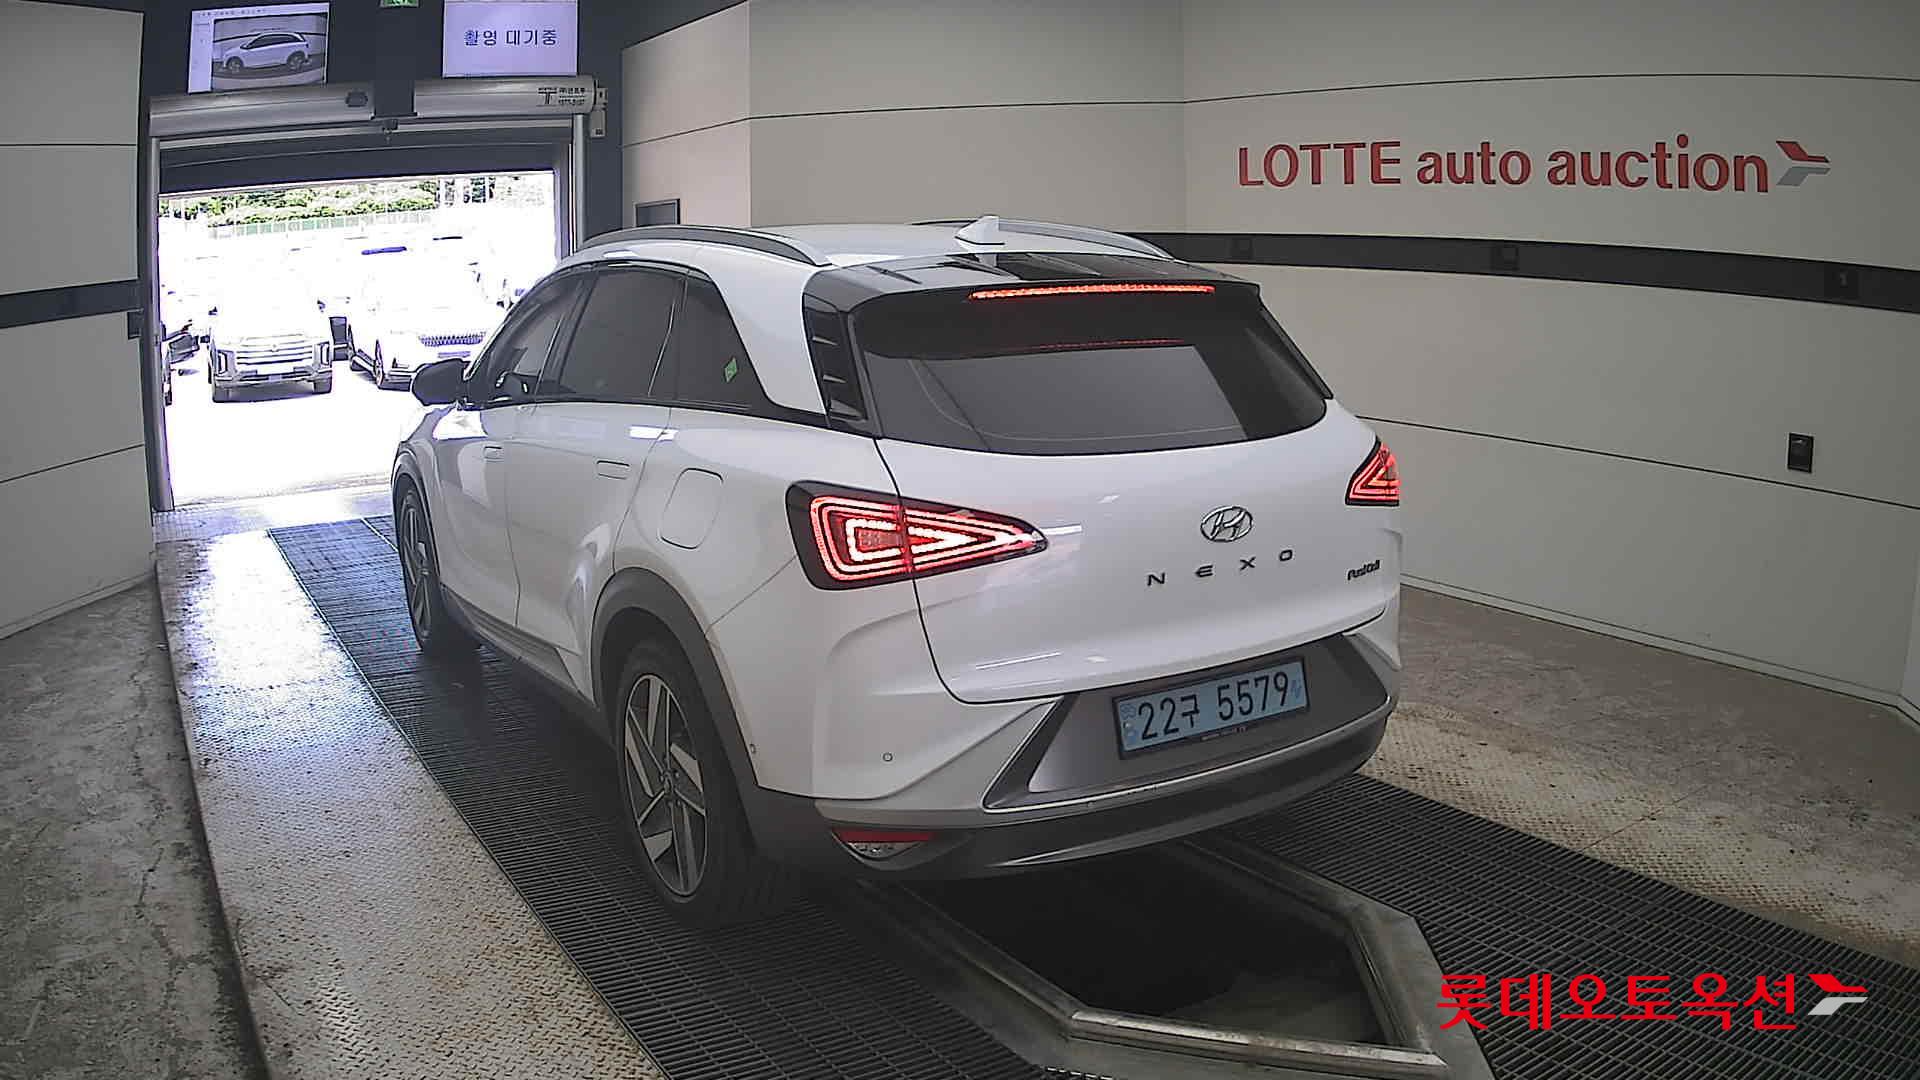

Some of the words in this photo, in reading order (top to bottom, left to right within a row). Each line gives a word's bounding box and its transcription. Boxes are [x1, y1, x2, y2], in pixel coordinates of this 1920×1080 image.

[505, 29, 557, 46] 대기중
[1238, 141, 1401, 188] LOTTE
[1417, 141, 1532, 185] auto
[1547, 133, 1769, 193] auction
[1147, 549, 1293, 586] NEXO
[1138, 694, 1200, 740] 22구
[1216, 671, 1289, 721] 5579
